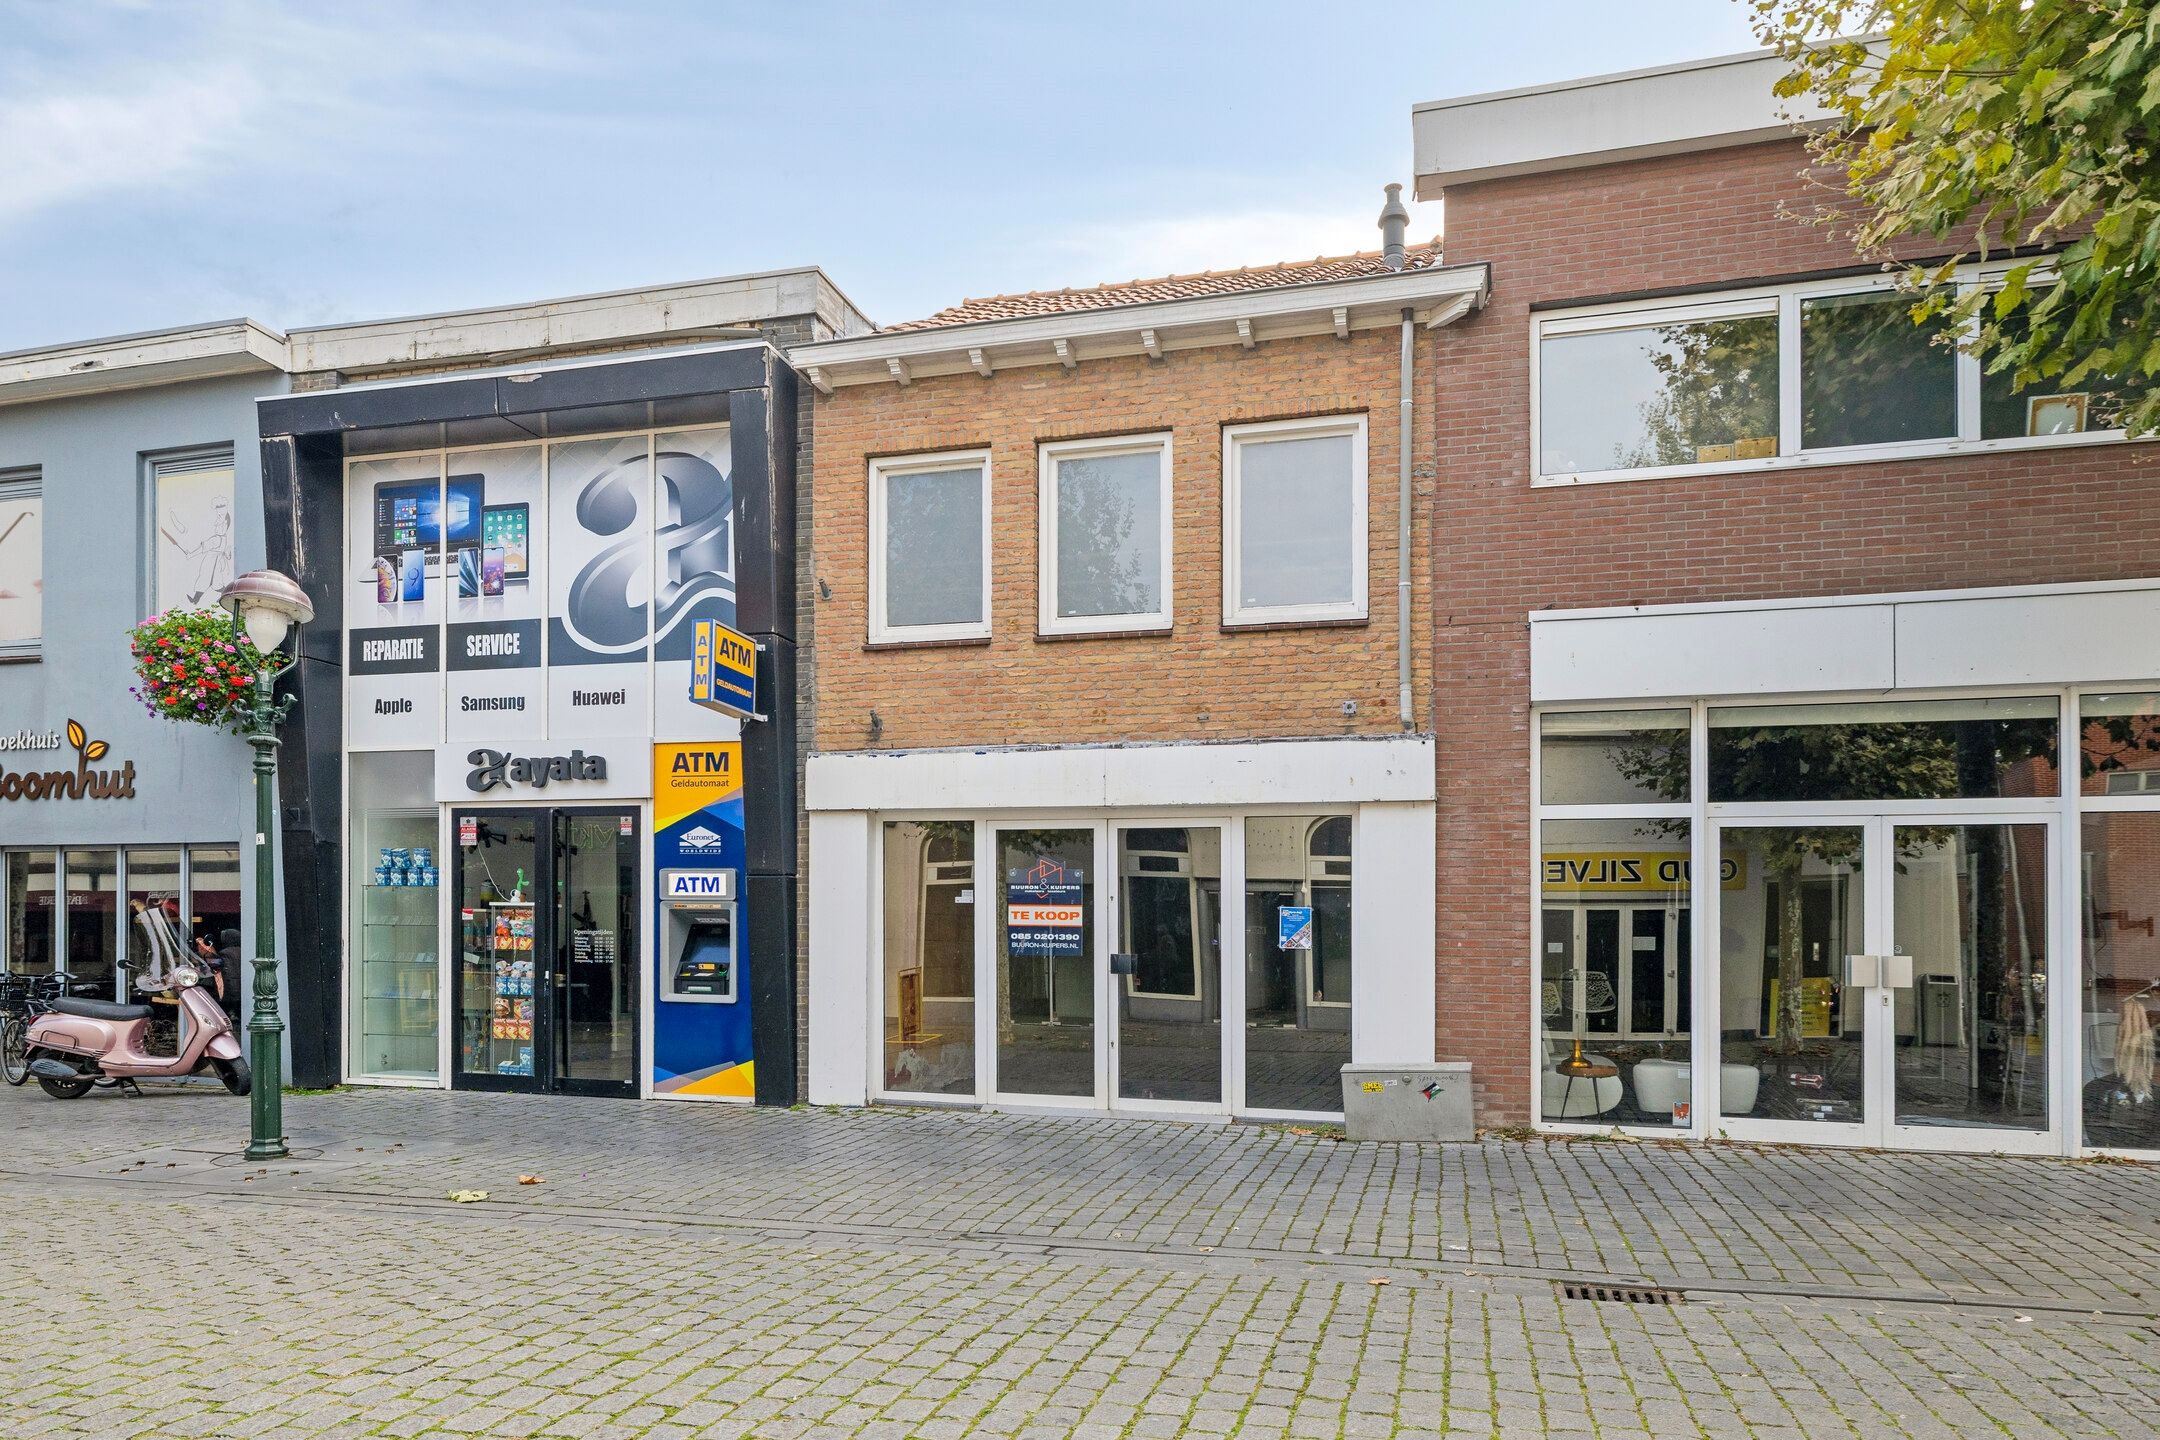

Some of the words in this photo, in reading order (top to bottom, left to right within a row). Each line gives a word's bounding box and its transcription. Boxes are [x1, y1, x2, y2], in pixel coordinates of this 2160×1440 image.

[363, 638, 424, 662] REPARATIE
[466, 632, 520, 657] SERVICE
[720, 637, 751, 668] ATM
[695, 636, 707, 685] ATM
[374, 697, 413, 715] Apple
[461, 695, 526, 712] Samsung
[572, 688, 626, 706] Huawei
[672, 752, 729, 773] ATM
[0, 757, 136, 801] oomhut
[671, 778, 730, 788] Geldautomaat
[686, 833, 715, 841] Euronet
[675, 877, 719, 892] ATM
[1011, 911, 1030, 920] TE
[1034, 911, 1080, 921] KOOP
[1011, 941, 1079, 949] BUURON-KUIPERS.NL
